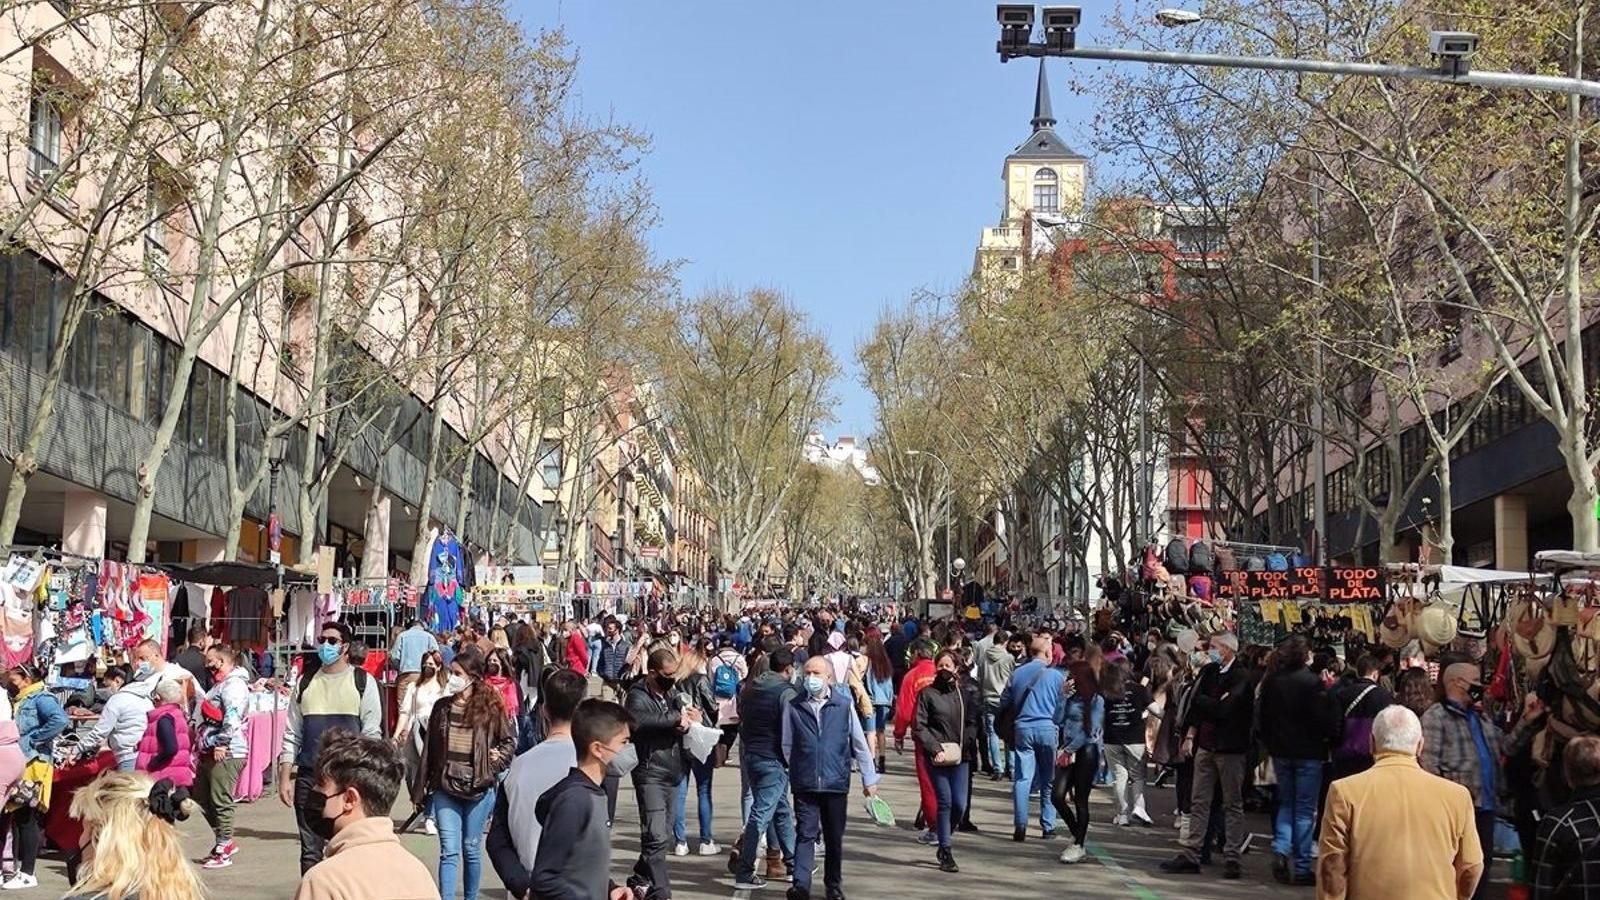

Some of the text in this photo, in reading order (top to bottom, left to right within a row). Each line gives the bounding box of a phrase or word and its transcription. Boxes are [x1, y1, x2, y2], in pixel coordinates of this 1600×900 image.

[1333, 569, 1377, 580] TODO
[1347, 579, 1363, 588] DE
[1252, 587, 1289, 597] PLAT
[1329, 587, 1381, 599] PLATA
